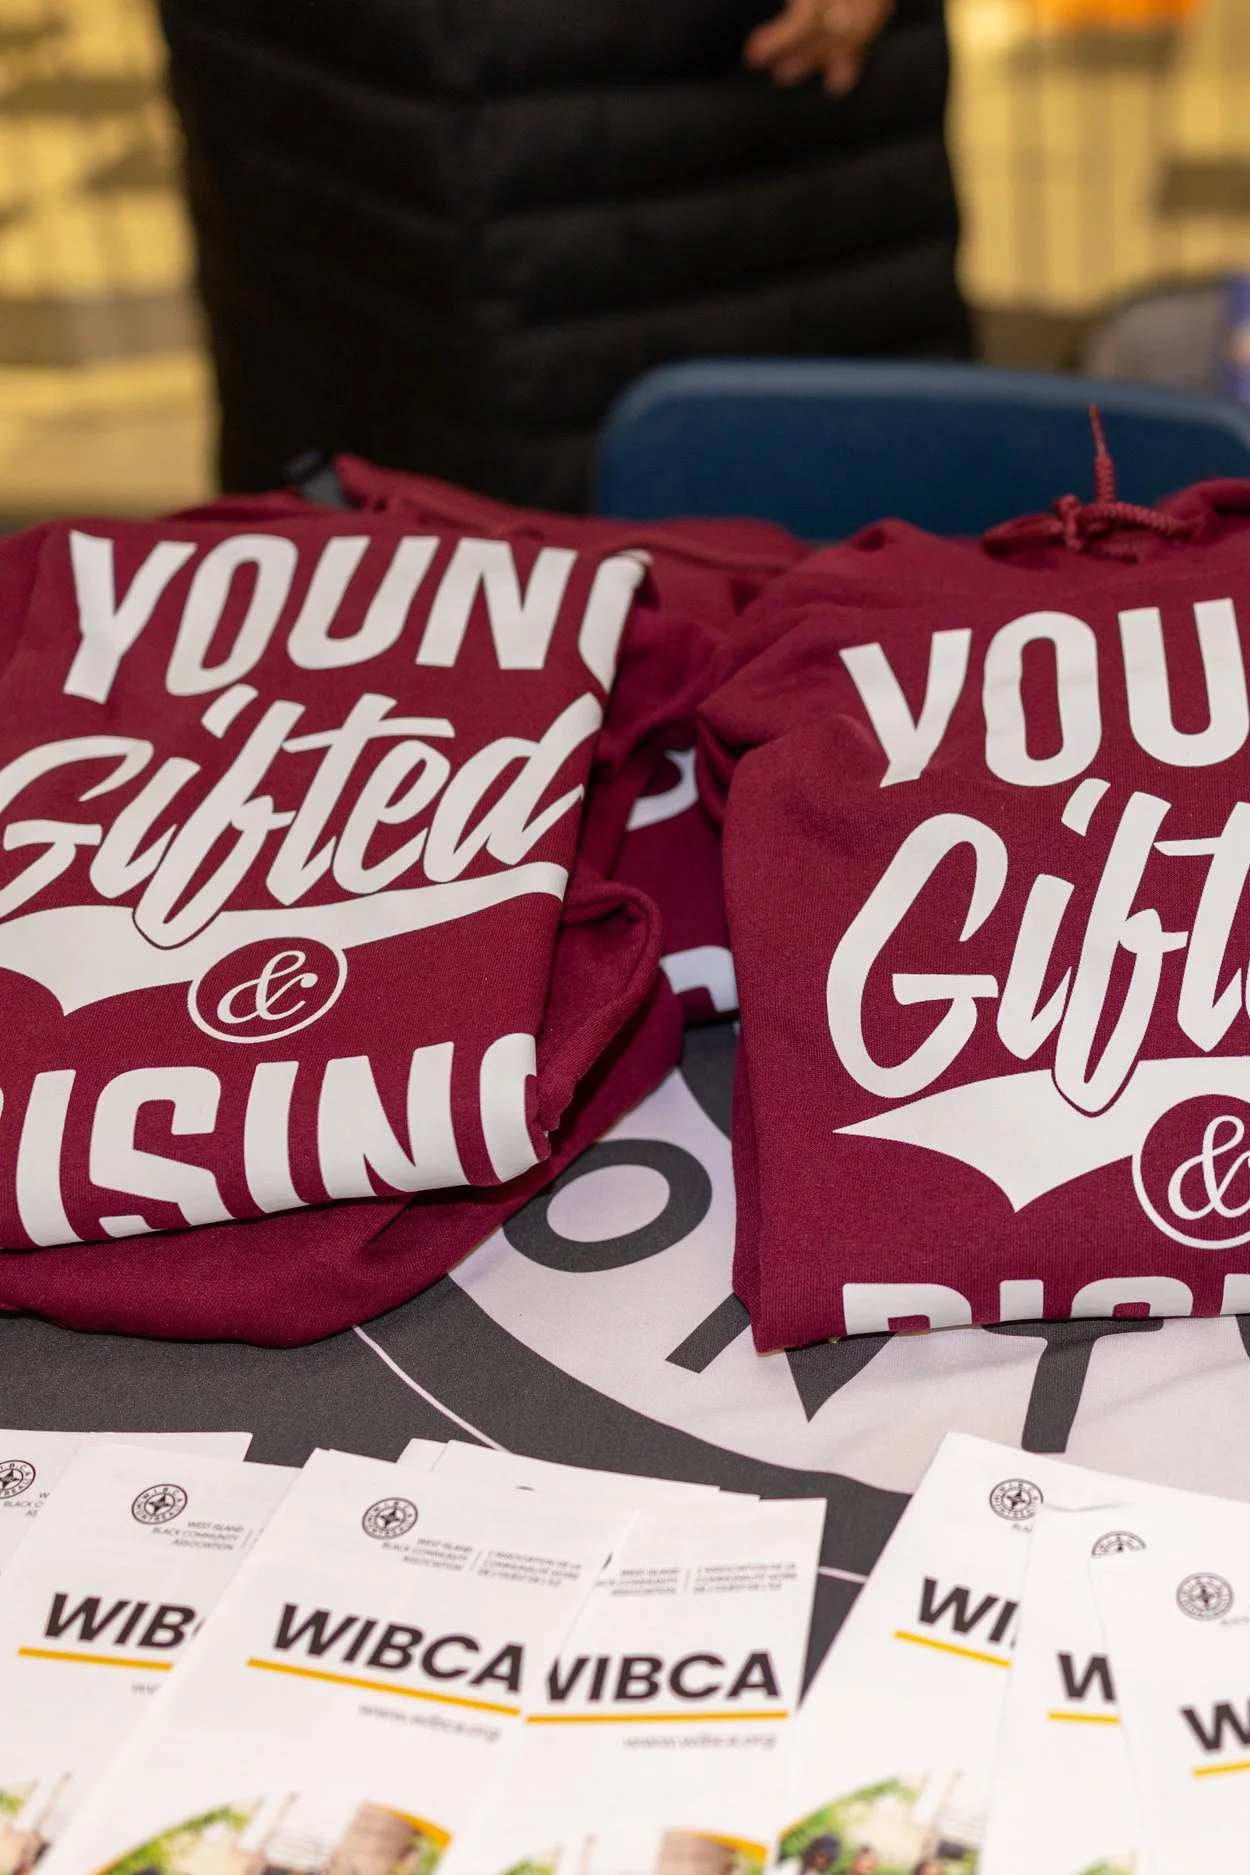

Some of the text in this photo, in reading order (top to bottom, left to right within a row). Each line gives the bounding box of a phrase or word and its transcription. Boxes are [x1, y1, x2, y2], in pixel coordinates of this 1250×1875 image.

[217, 949, 318, 1025] &
[44, 1591, 205, 1650] WIB
[273, 1602, 526, 1695] WIBCA
